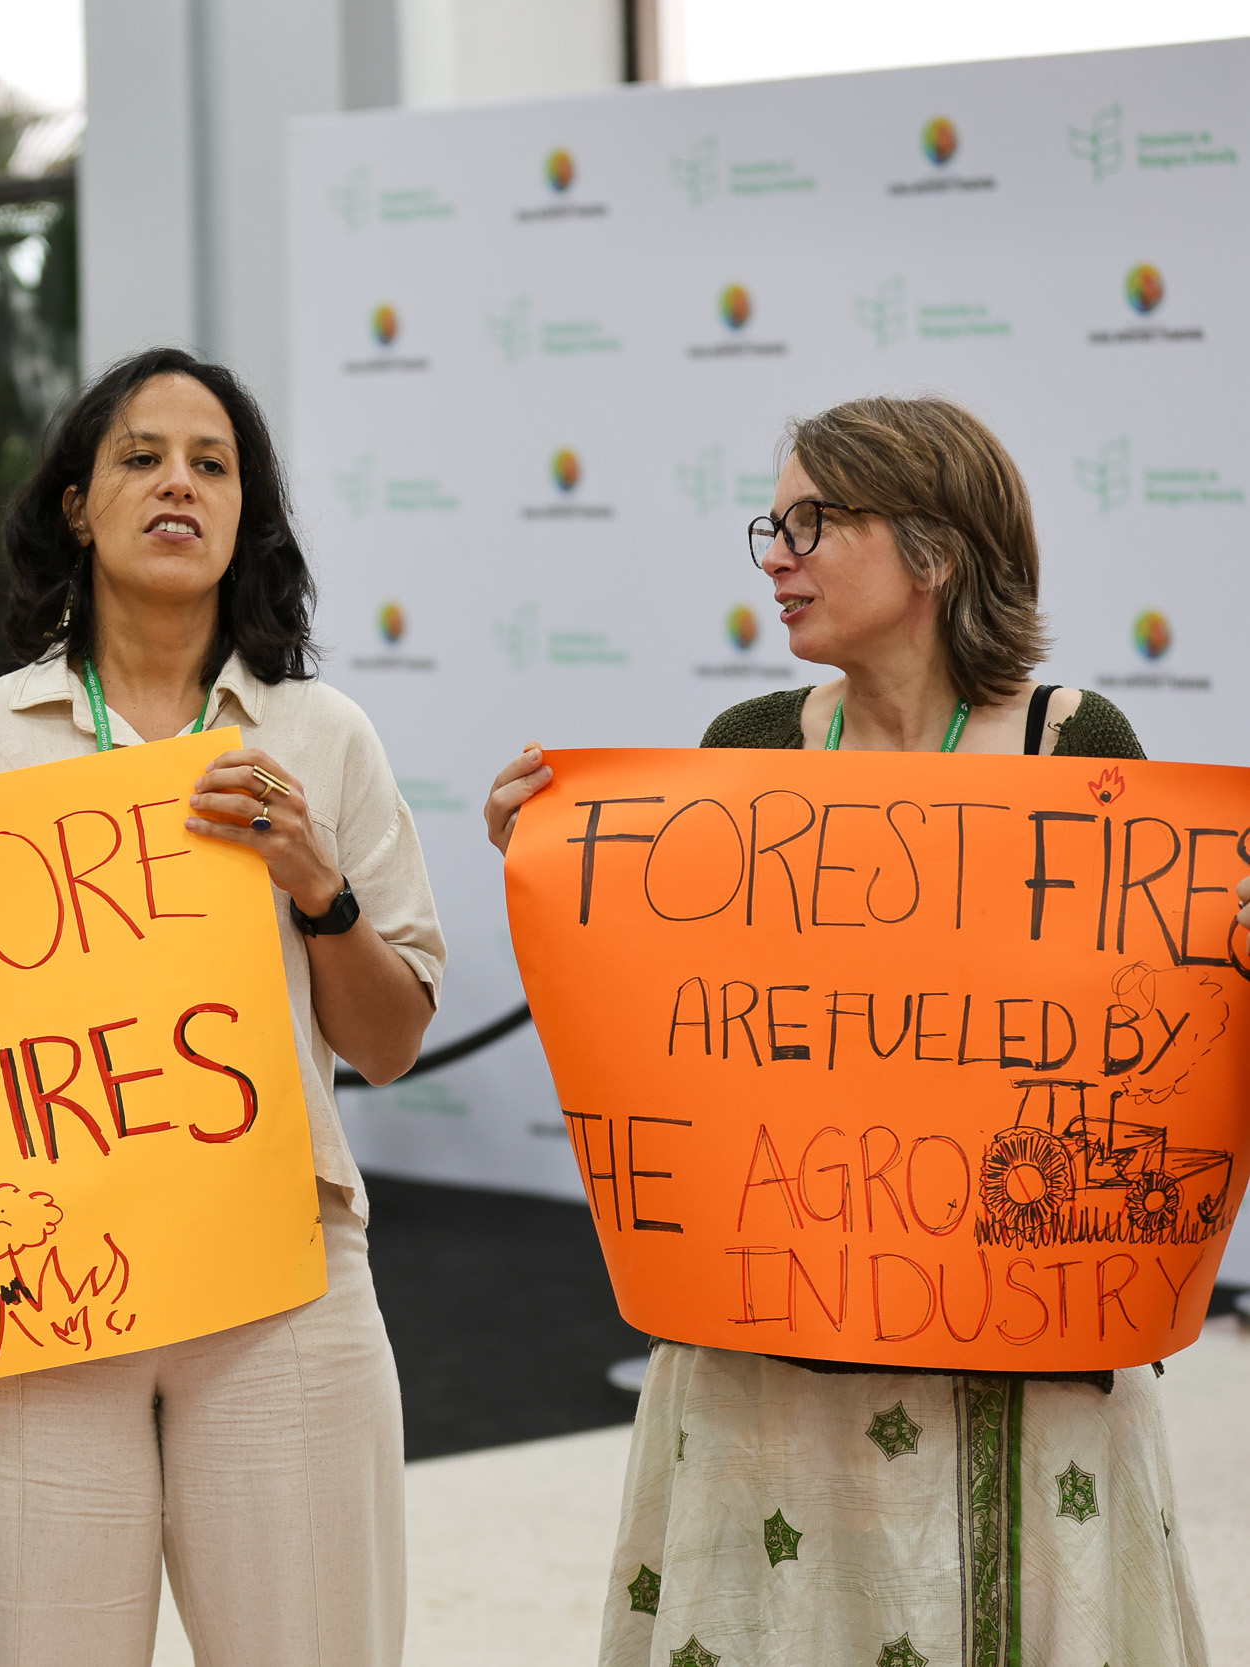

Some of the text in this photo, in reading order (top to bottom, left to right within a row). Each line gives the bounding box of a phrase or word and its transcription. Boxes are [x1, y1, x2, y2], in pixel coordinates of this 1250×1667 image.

[94, 695, 105, 723] Biological
[99, 724, 109, 751] Diversity
[947, 713, 965, 749] Convention
[567, 790, 1010, 934] FOREST
[669, 977, 1192, 1077] ARE FUELED BY
[562, 1109, 971, 1237] THE AGRO
[725, 1244, 1203, 1346] INDUSTRY
